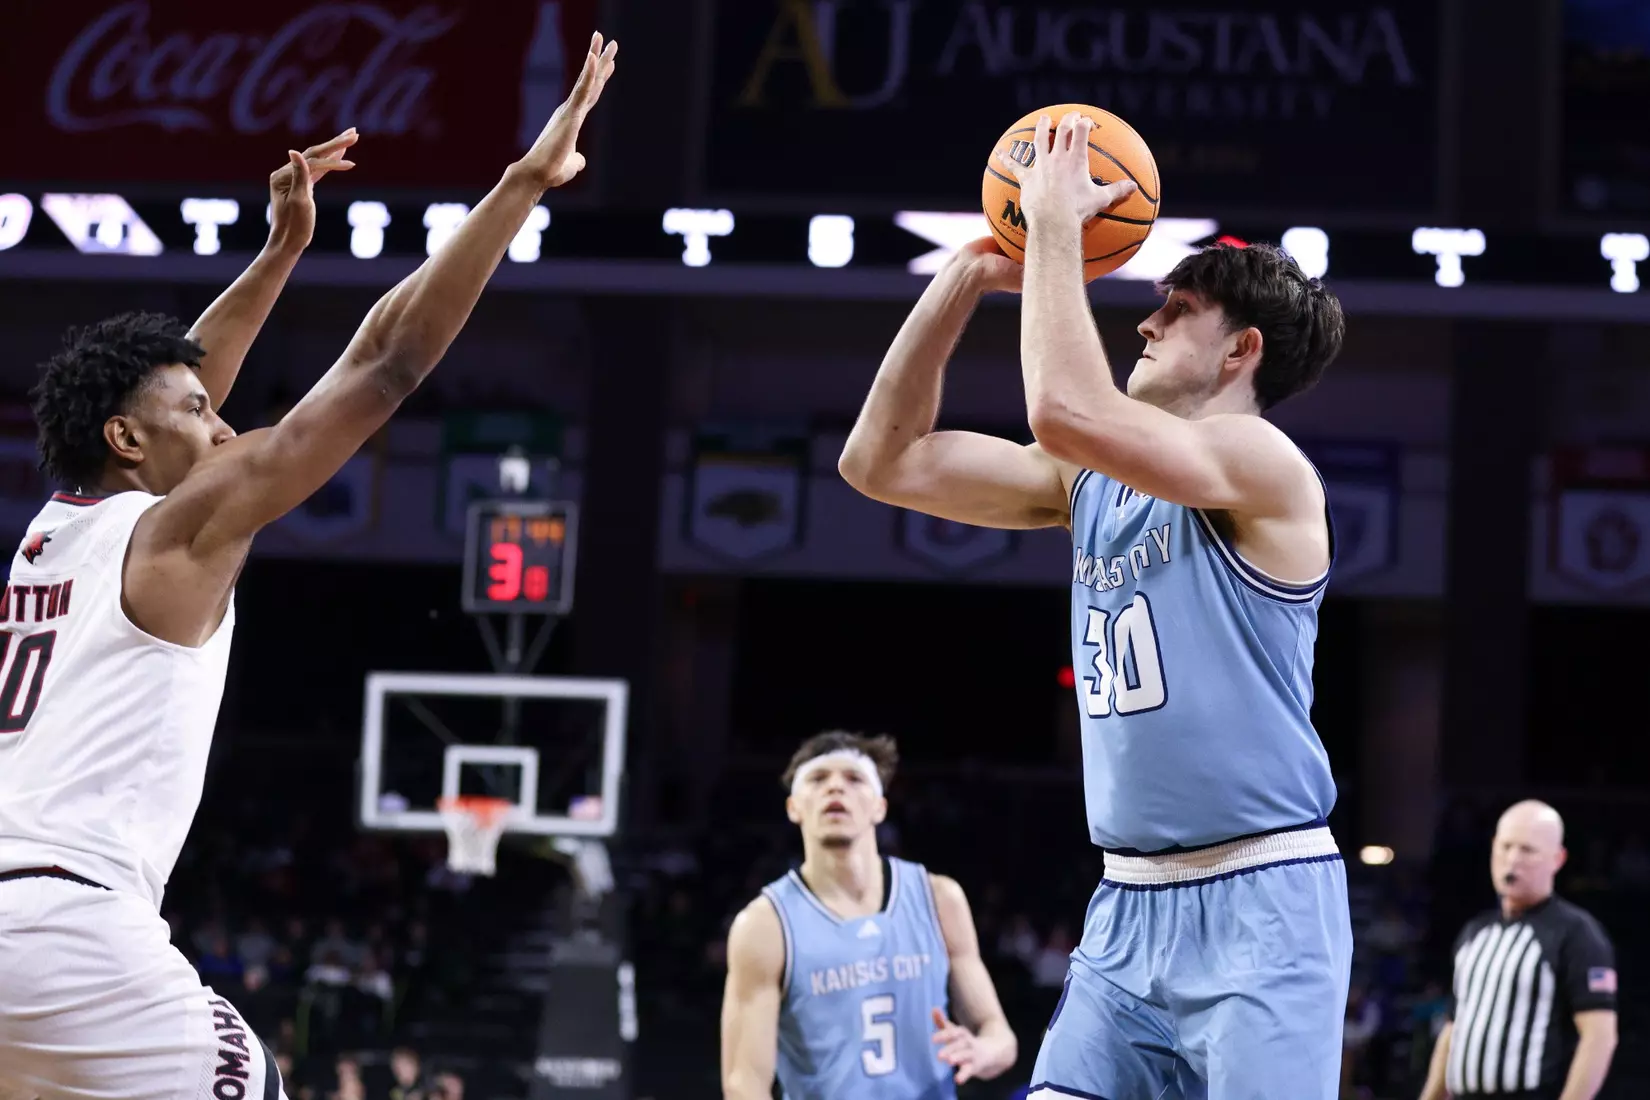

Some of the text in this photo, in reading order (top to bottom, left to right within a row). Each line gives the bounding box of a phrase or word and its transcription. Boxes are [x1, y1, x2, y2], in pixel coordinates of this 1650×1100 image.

[936, 3, 1414, 84] AUGUSTANA
[1083, 590, 1169, 719] 30
[861, 993, 897, 1078] 5
